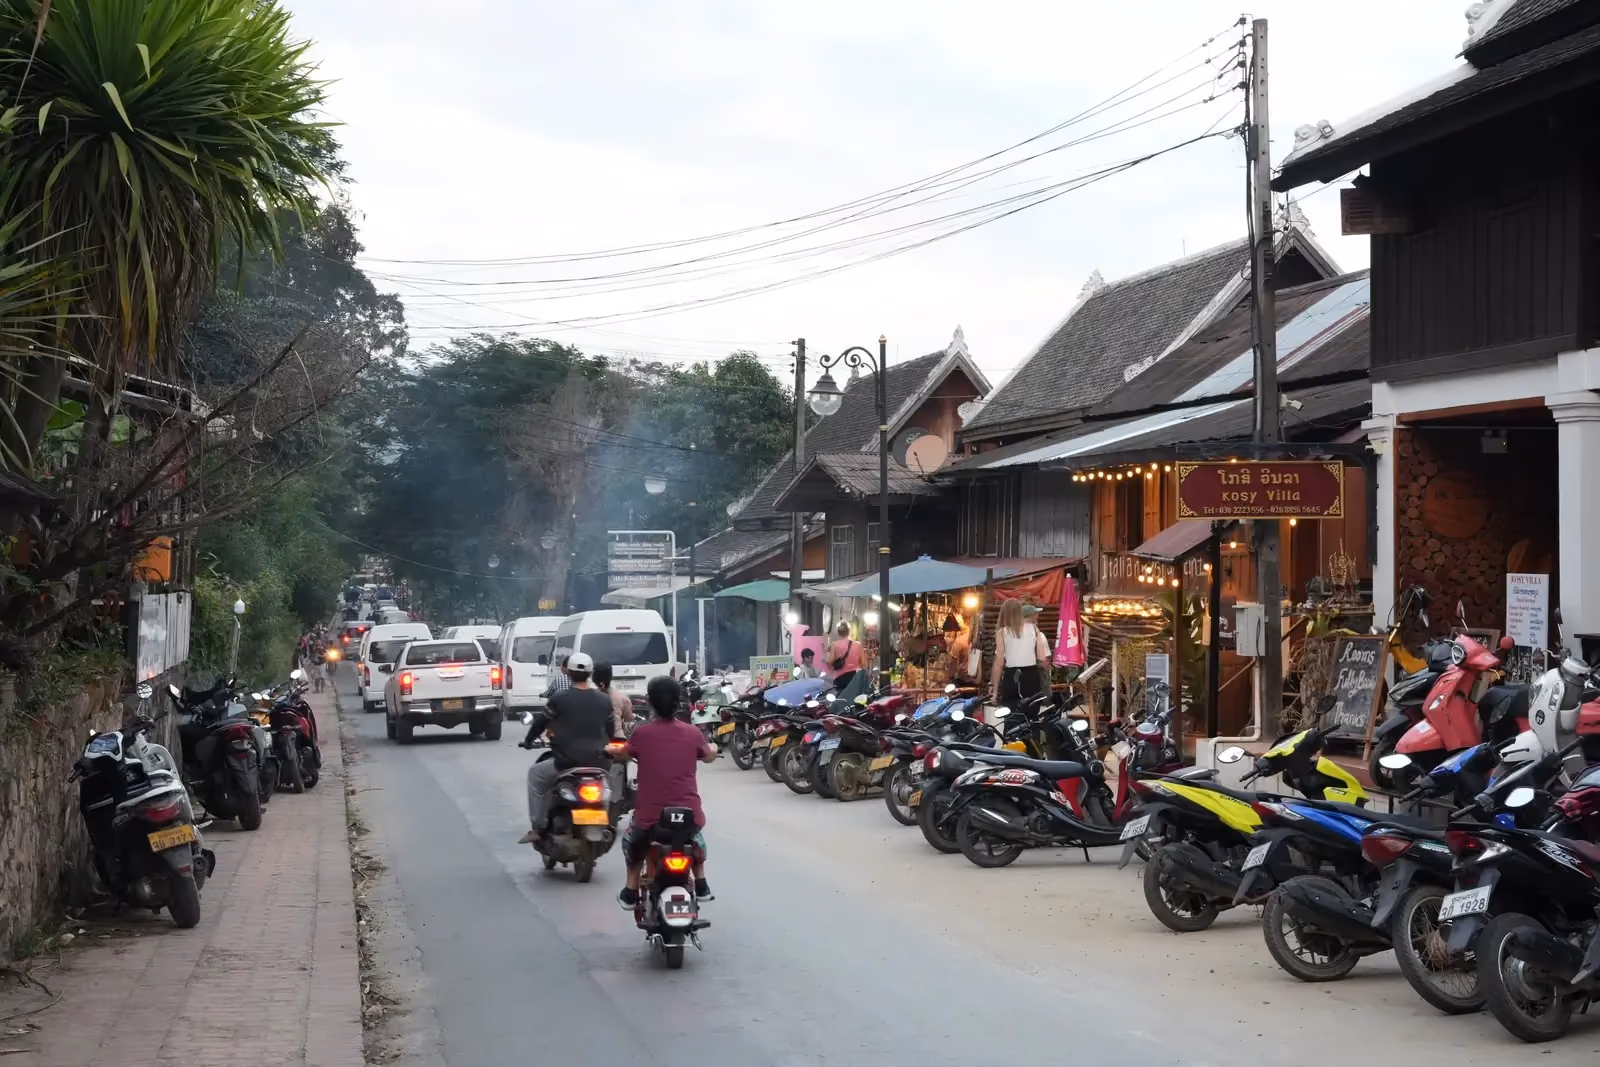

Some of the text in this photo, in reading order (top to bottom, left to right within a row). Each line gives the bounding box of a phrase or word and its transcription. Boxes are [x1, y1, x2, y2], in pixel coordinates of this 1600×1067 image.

[1266, 489, 1301, 501] Villa
[1339, 641, 1375, 665] Rooms
[1334, 701, 1366, 727] Thanks
[1460, 898, 1486, 912] 1928
